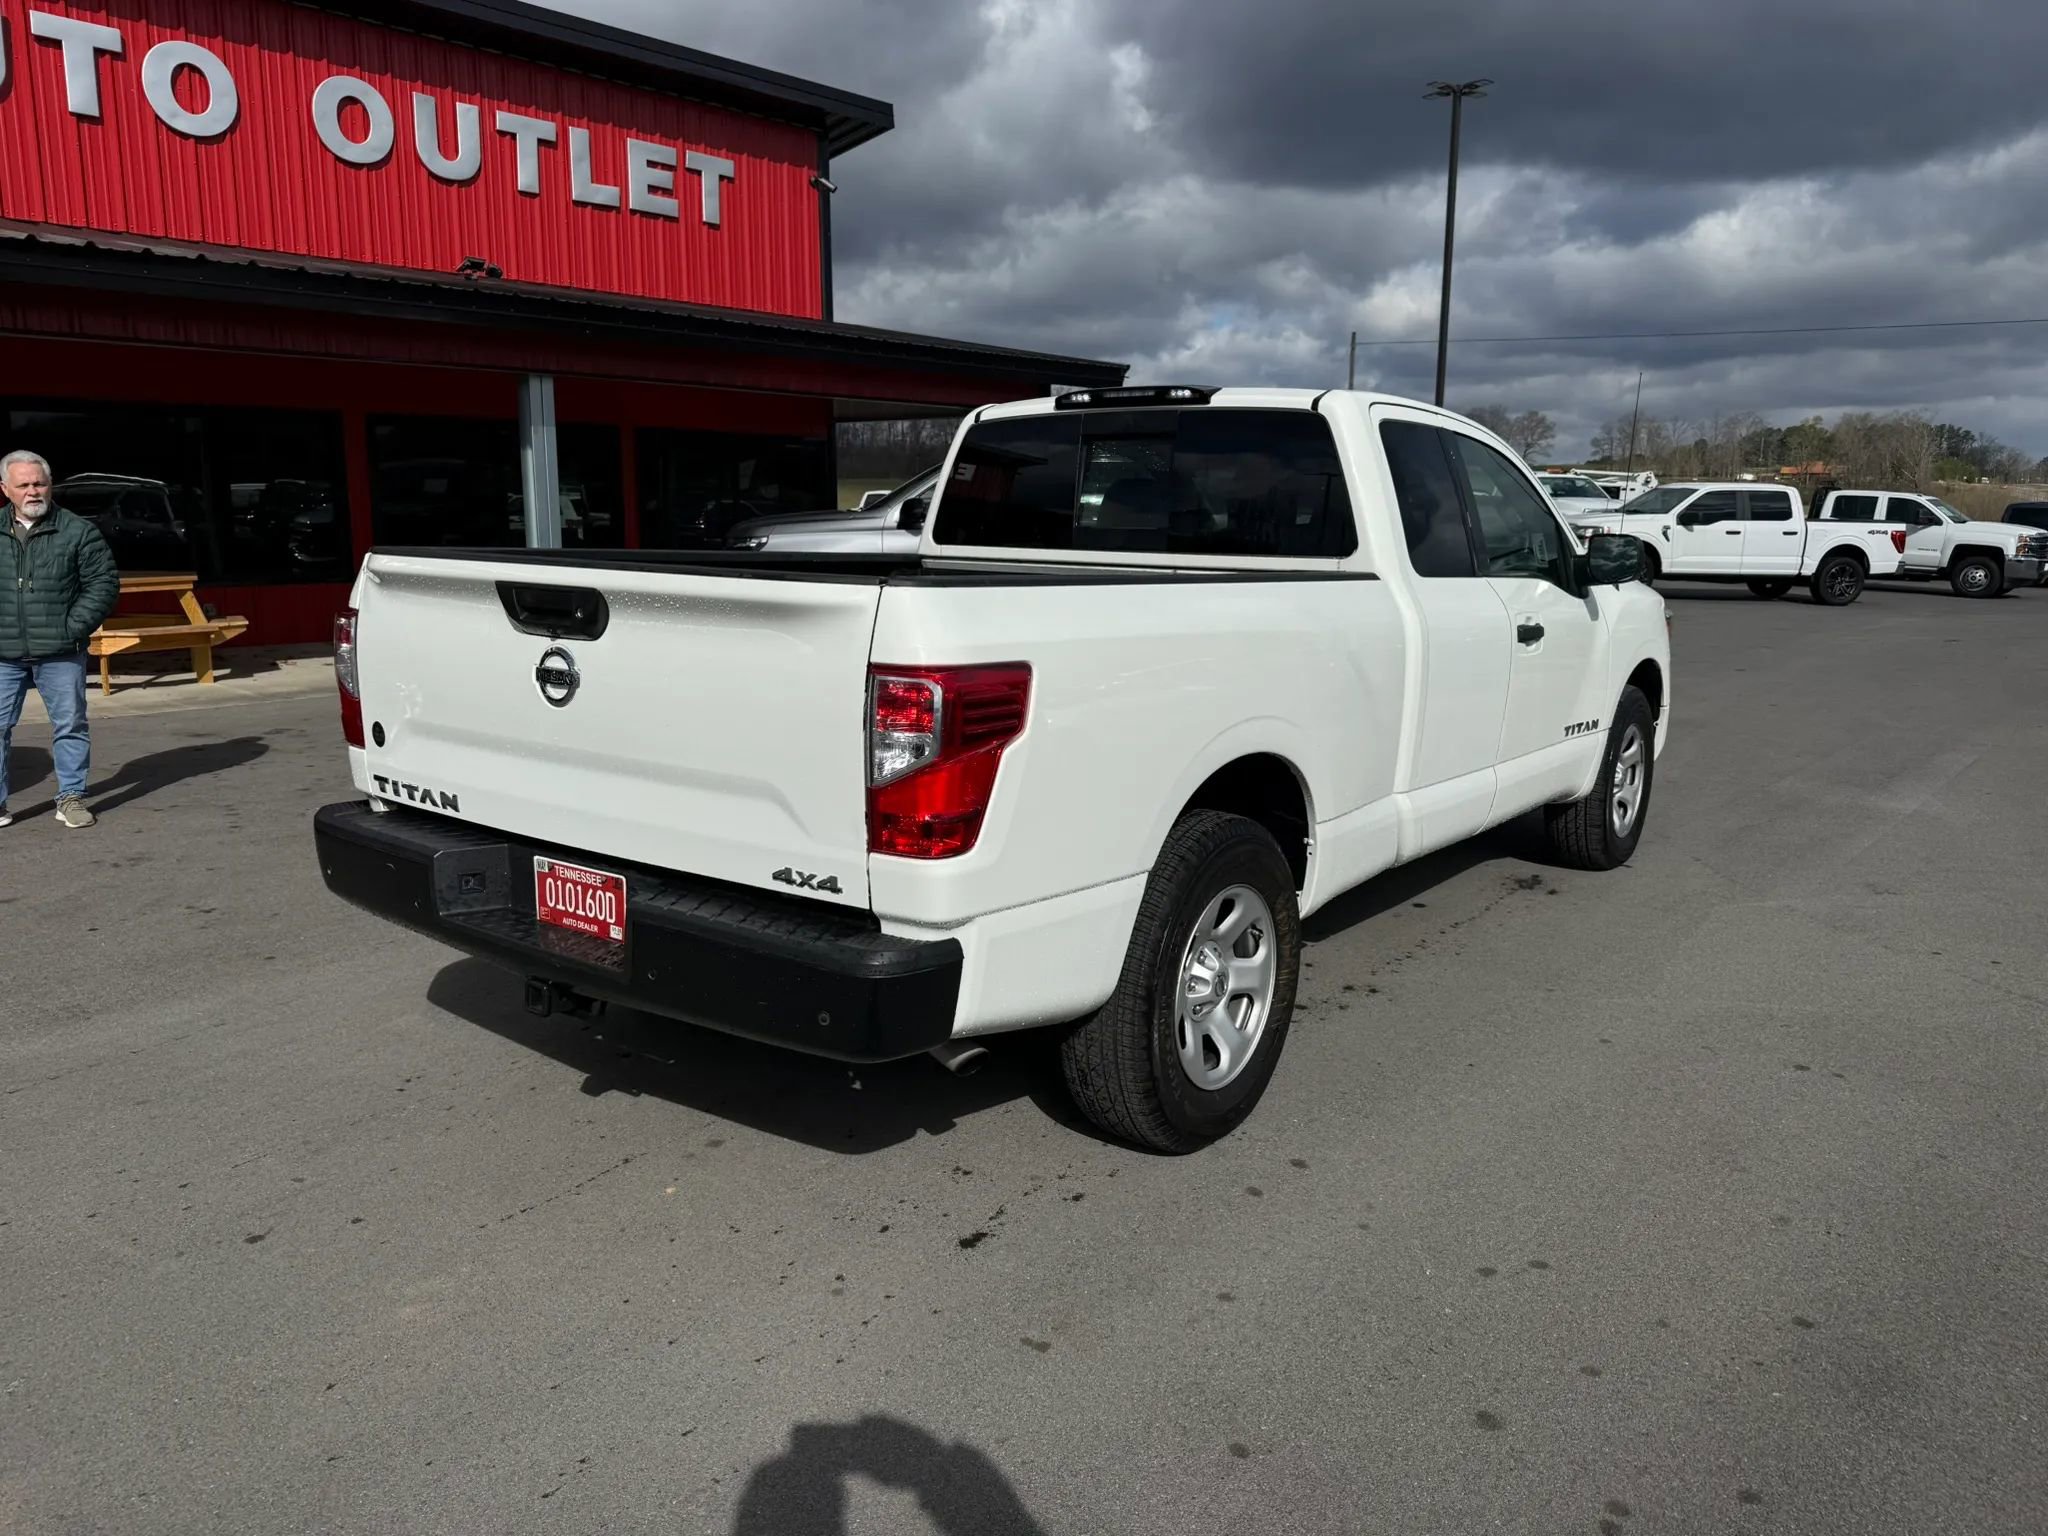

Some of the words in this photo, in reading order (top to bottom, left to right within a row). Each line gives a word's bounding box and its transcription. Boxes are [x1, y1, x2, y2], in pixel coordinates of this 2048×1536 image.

[0, 9, 239, 137] TO
[312, 75, 735, 226] OUTLET
[1564, 718, 1599, 737] TITAN
[373, 774, 460, 813] TITAN
[554, 866, 602, 887] TENNESSEE
[546, 878, 616, 923] 010160D
[562, 917, 577, 927] AUTO
[577, 921, 599, 933] DEALER
